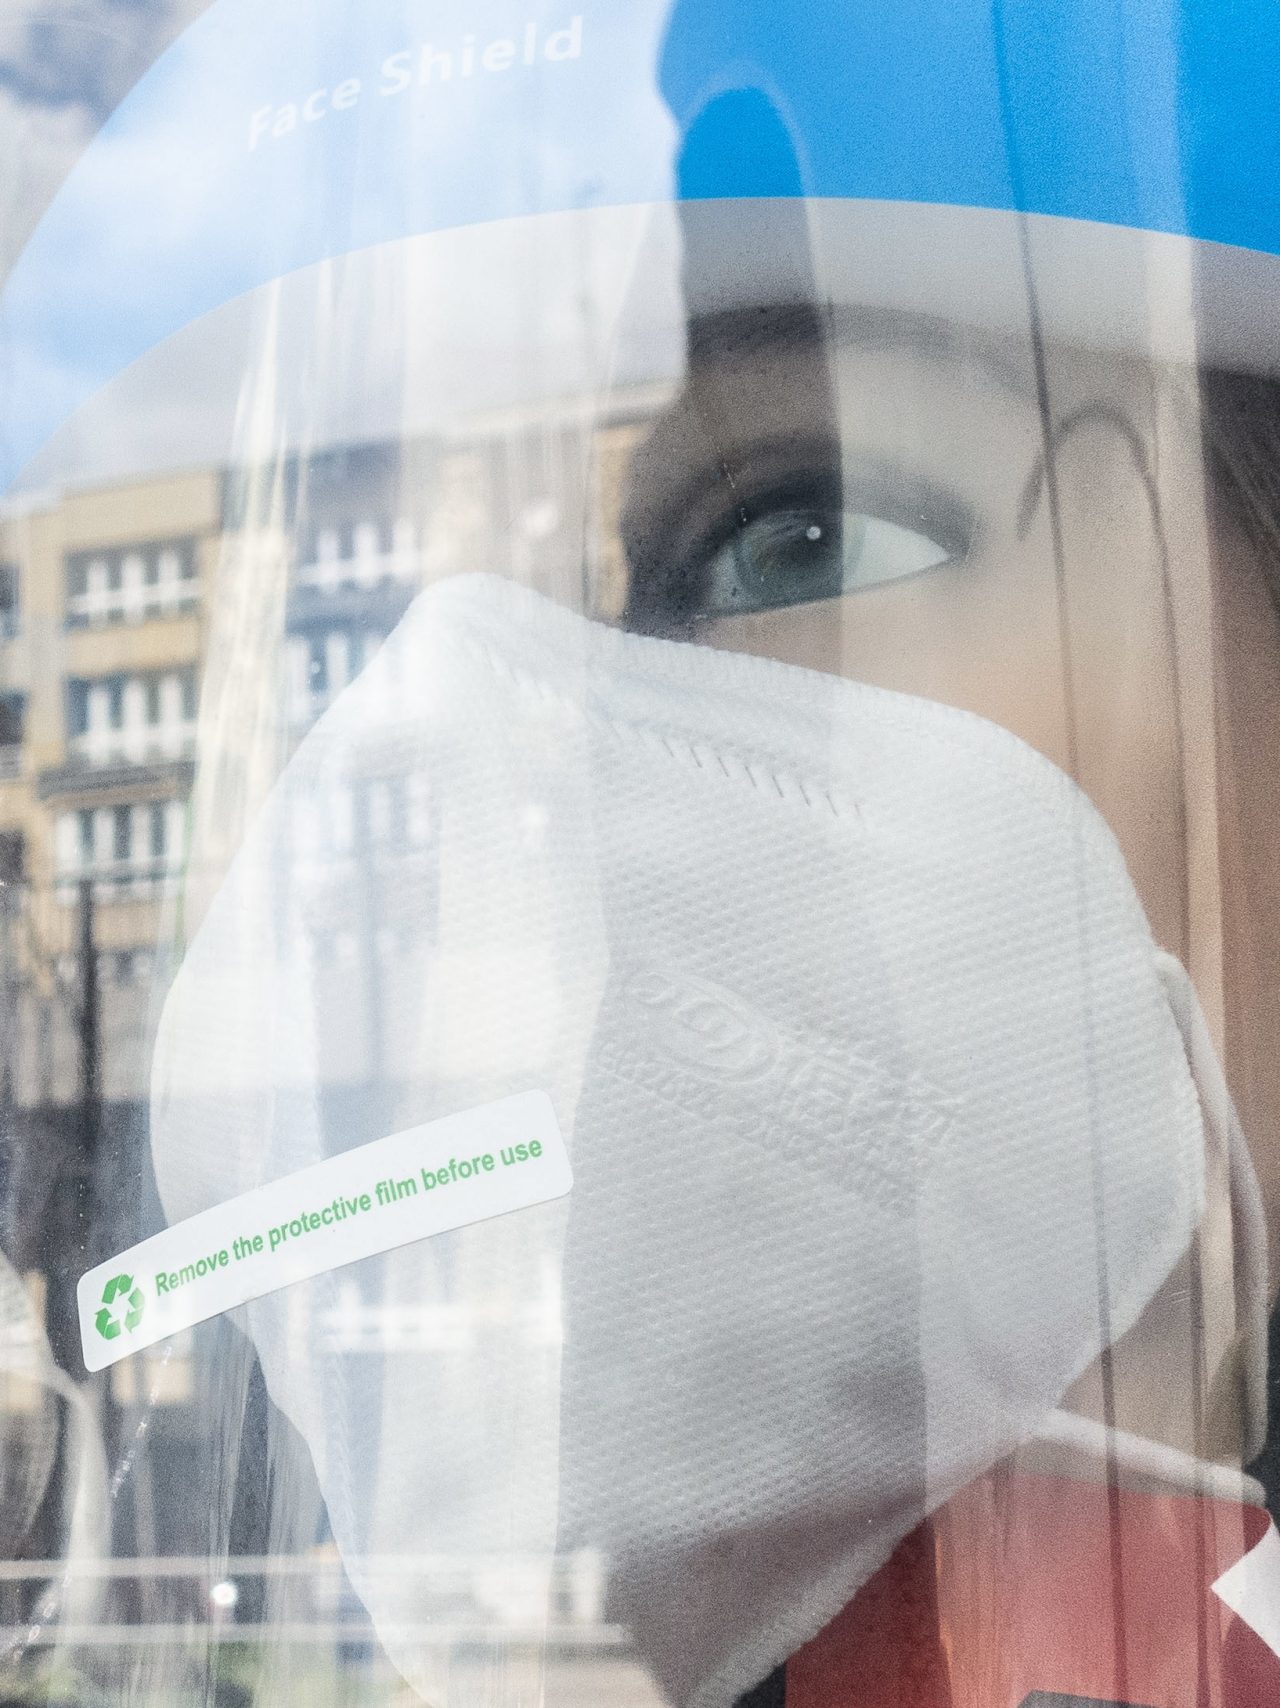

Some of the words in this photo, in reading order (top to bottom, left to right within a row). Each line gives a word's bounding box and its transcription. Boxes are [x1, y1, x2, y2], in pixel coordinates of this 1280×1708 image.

[248, 78, 363, 152] Face
[379, 15, 584, 98] Shield
[154, 1247, 230, 1296] Remove
[232, 1233, 265, 1259] the
[268, 1191, 373, 1251] protective
[375, 1176, 419, 1206] film
[420, 1152, 497, 1191] before
[500, 1138, 544, 1168] use
